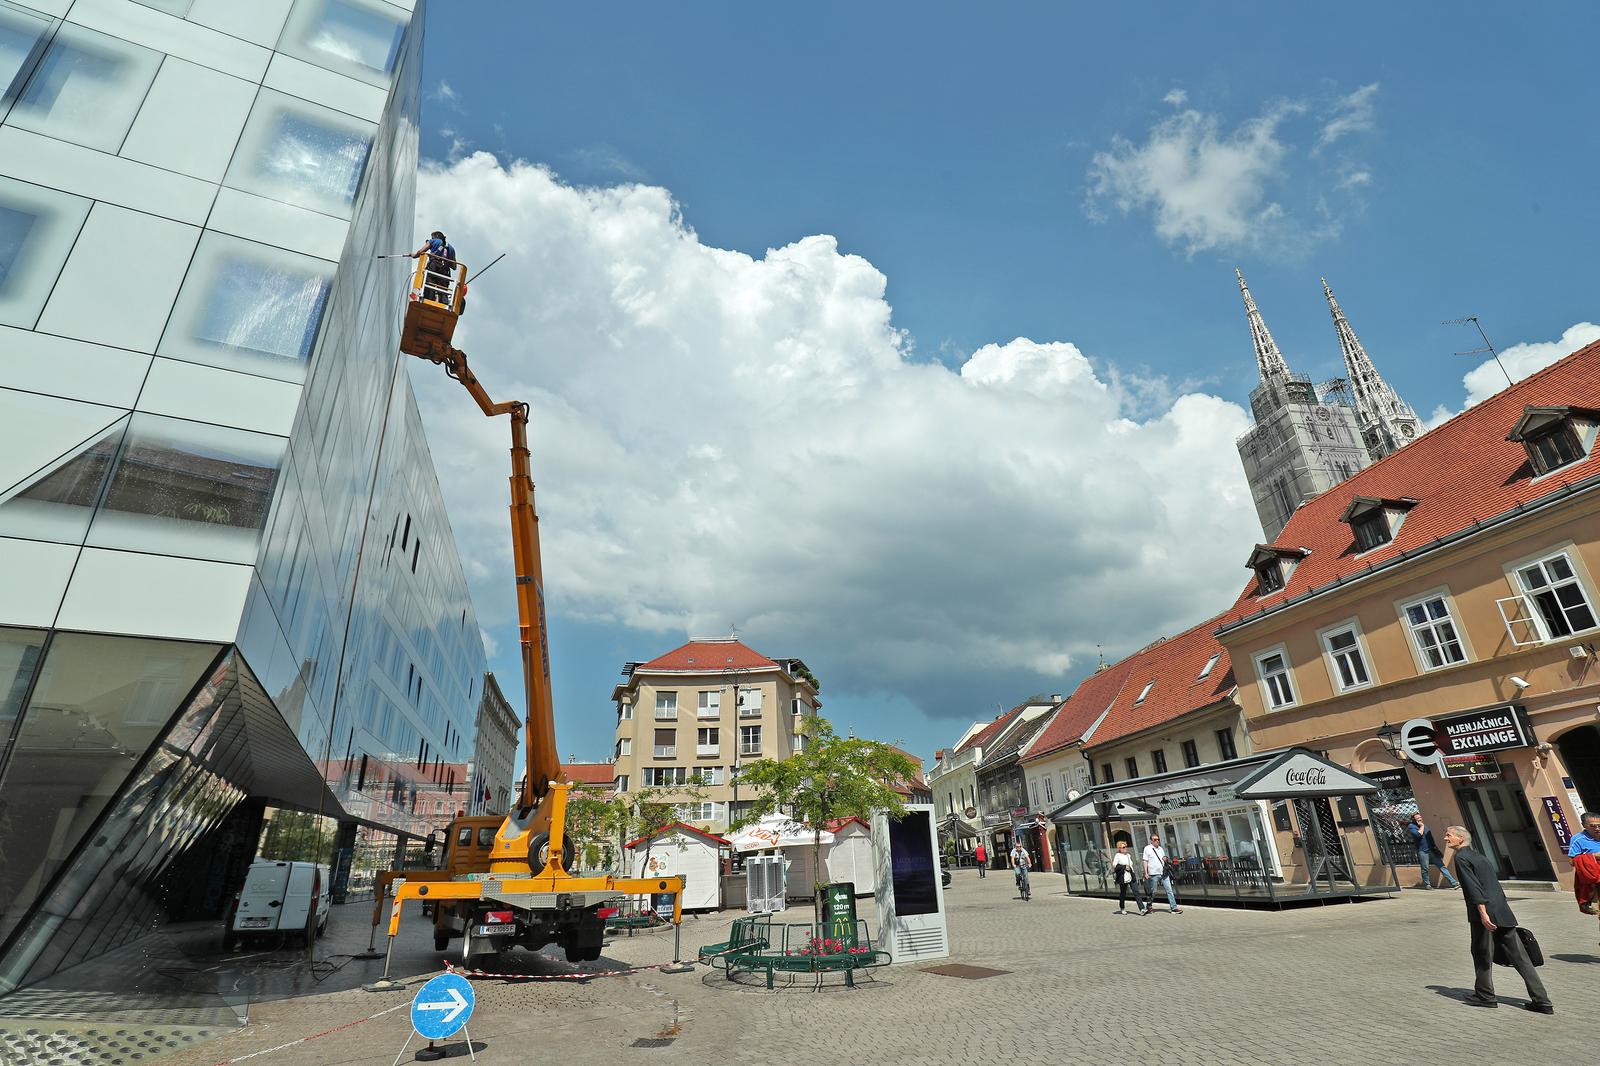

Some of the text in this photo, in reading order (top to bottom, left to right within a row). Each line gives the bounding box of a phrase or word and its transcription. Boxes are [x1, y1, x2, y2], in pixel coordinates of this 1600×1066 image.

[1446, 716, 1512, 735] MJENJAČNICA
[1451, 730, 1517, 750] EXCHANGE
[1286, 767, 1326, 786] Coca-Cola
